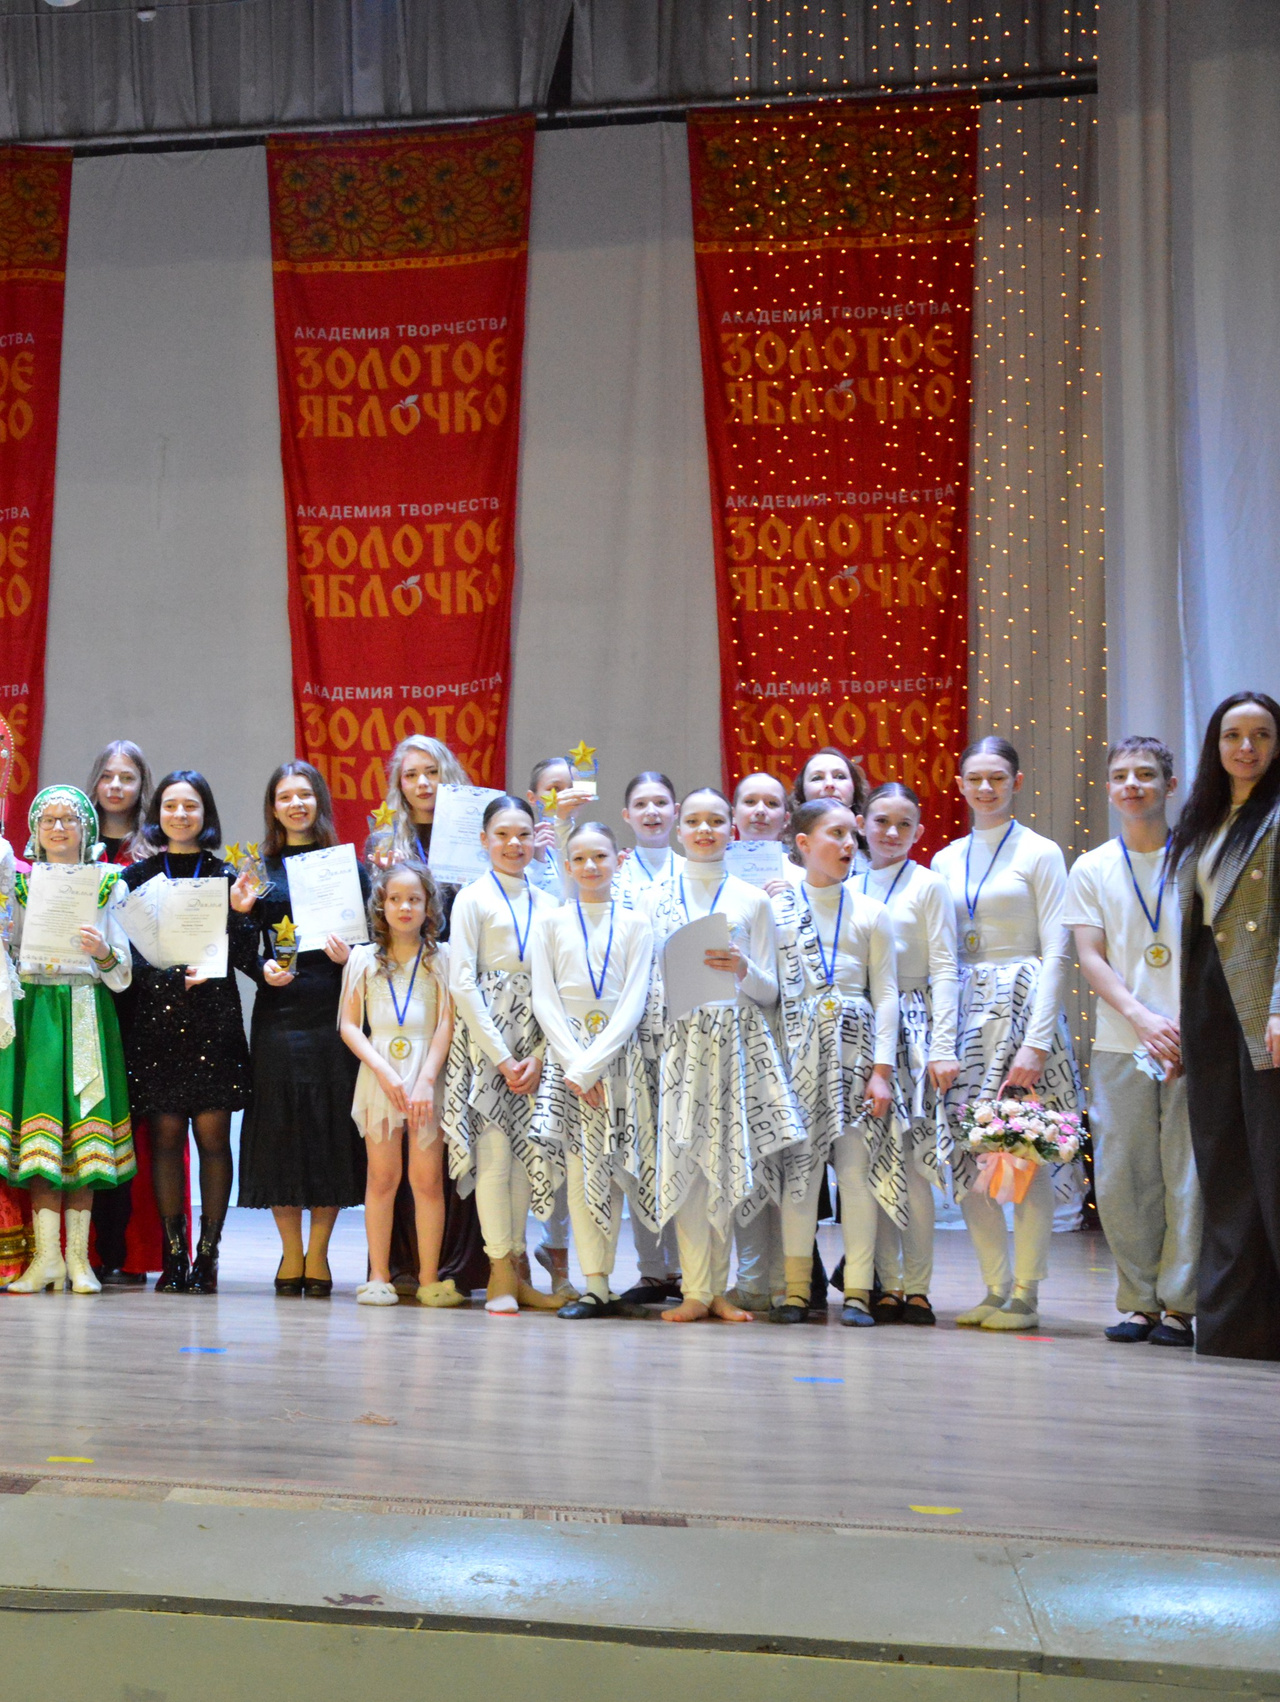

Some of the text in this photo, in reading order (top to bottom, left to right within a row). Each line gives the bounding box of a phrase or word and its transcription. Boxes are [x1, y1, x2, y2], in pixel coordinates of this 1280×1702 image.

[295, 317, 507, 341] АКАДЕМИЯ ТВОРЧЕСТВА
[721, 302, 952, 325] АКАДЕМИЯ ТВОРЧЕСТВА
[294, 338, 507, 389] ЗОЛОТОЕ
[721, 323, 954, 376] ЗОЛОТОЕ
[296, 384, 507, 438] ЯБЛОЧКО
[724, 373, 955, 425] ЯБЛОЧКО
[297, 497, 500, 520] АКАДЕМИЯ ТВОРЧЕСТВ
[725, 484, 955, 510] АКАДЕМИЯ ТВОРЧЕСТВА
[725, 505, 954, 561] ЗОЛОТОЕ
[728, 556, 950, 611] ЯБЛОЧКО
